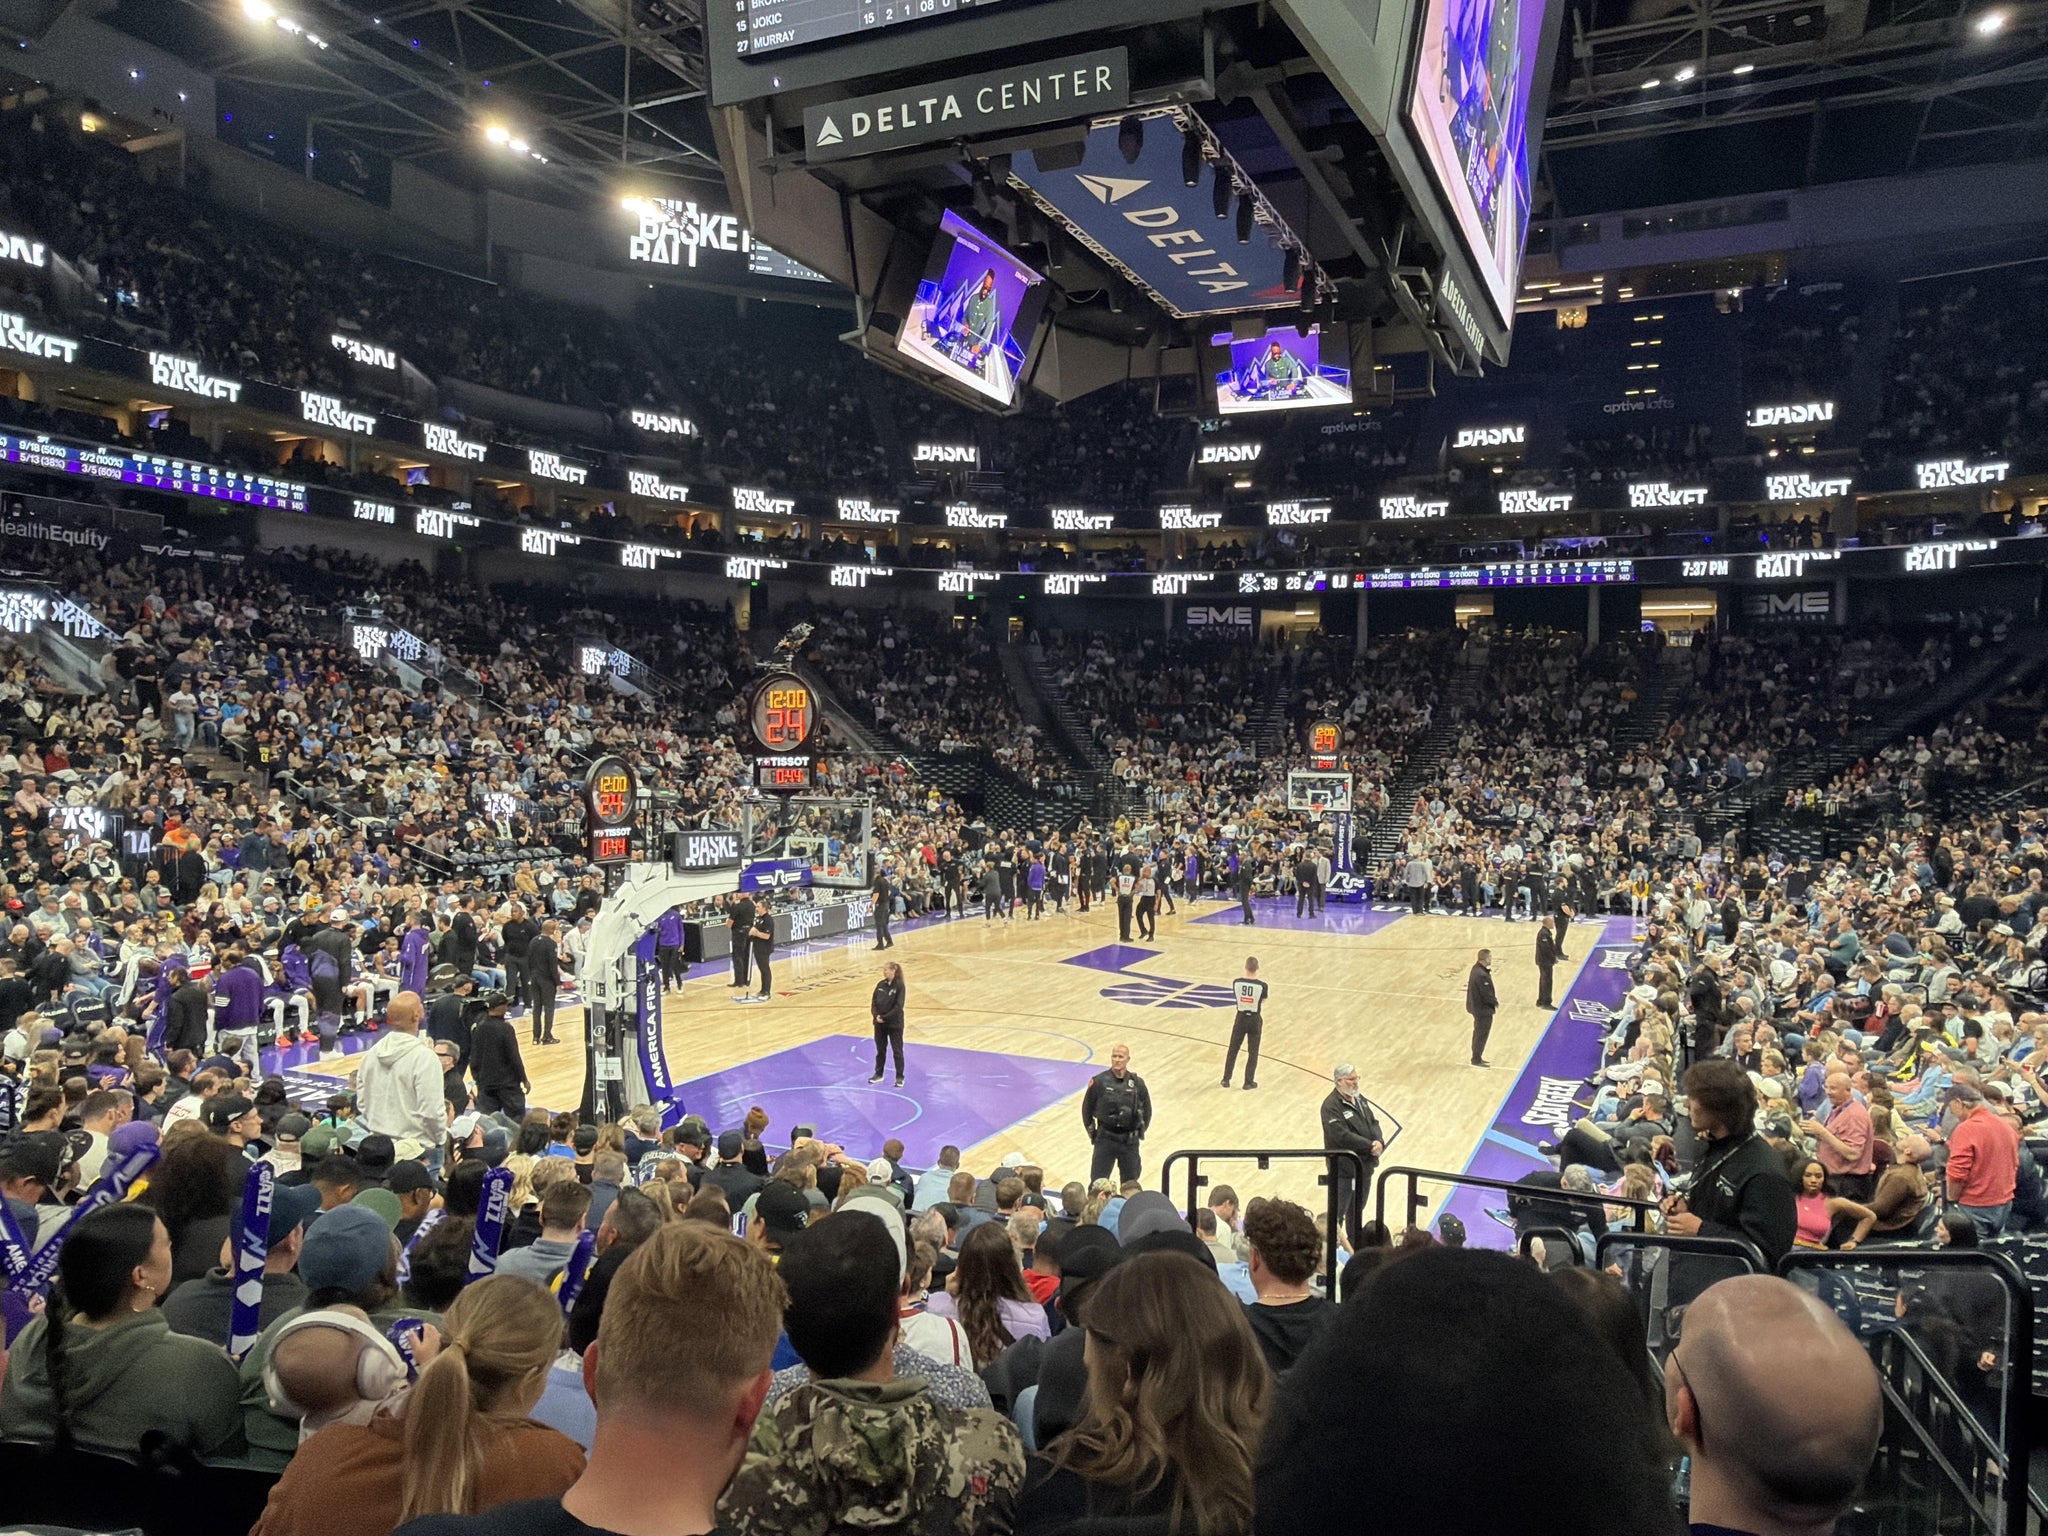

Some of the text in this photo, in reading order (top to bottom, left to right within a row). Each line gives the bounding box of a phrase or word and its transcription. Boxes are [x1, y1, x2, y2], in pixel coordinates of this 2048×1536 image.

[736, 13, 782, 32] 15 JOKIC
[737, 40, 748, 52] 27
[754, 30, 795, 49] MURRAY
[864, 12, 875, 24] 15
[886, 9, 893, 20] 2
[904, 5, 910, 16] 1
[852, 66, 1112, 137] DELTA CENTER
[1122, 206, 1249, 294] DELTA
[1447, 280, 1485, 356] DELTA CENTER
[1603, 396, 1675, 415] aptive lofts
[1321, 422, 1357, 436] aptive
[19, 440, 40, 453] 9/18
[41, 445, 66, 458] (50%)
[80, 451, 95, 463] 2/2
[96, 454, 123, 468] (100%)
[137, 463, 142, 471] 1
[173, 470, 182, 478] 15
[210, 476, 217, 484] 0
[227, 480, 234, 488] 0
[244, 483, 251, 491] 4
[275, 489, 288, 497] 140
[20, 453, 40, 464] 5/13
[41, 456, 66, 469] (38%)
[82, 464, 98, 474] 3/5
[98, 466, 122, 479] (60%)
[136, 474, 142, 482] 3
[156, 477, 162, 485] 7
[173, 481, 182, 489] 10
[210, 487, 217, 496] 2
[228, 490, 233, 499] 1
[244, 493, 250, 501] 0
[262, 496, 268, 504] 4
[292, 502, 304, 511] 140
[353, 500, 395, 524] 7:37 PM
[1682, 560, 1729, 577] 7:37 PM
[1263, 577, 1301, 590] 39 28
[1749, 591, 1829, 615] SME
[1187, 606, 1252, 625] SME
[769, 690, 807, 709] 12:00
[766, 709, 806, 743] 24
[1314, 735, 1336, 752] 24
[771, 756, 810, 767] TISSOT
[600, 776, 628, 793] 12:00
[775, 768, 803, 784] 0:44
[600, 793, 624, 816] 24
[604, 827, 631, 837] TISSOT
[601, 838, 627, 857] 0:44
[1241, 985, 1254, 998] 90
[645, 962, 666, 1089] AMERICA FIRT
[1521, 1076, 1585, 1126] SEATGEEK
